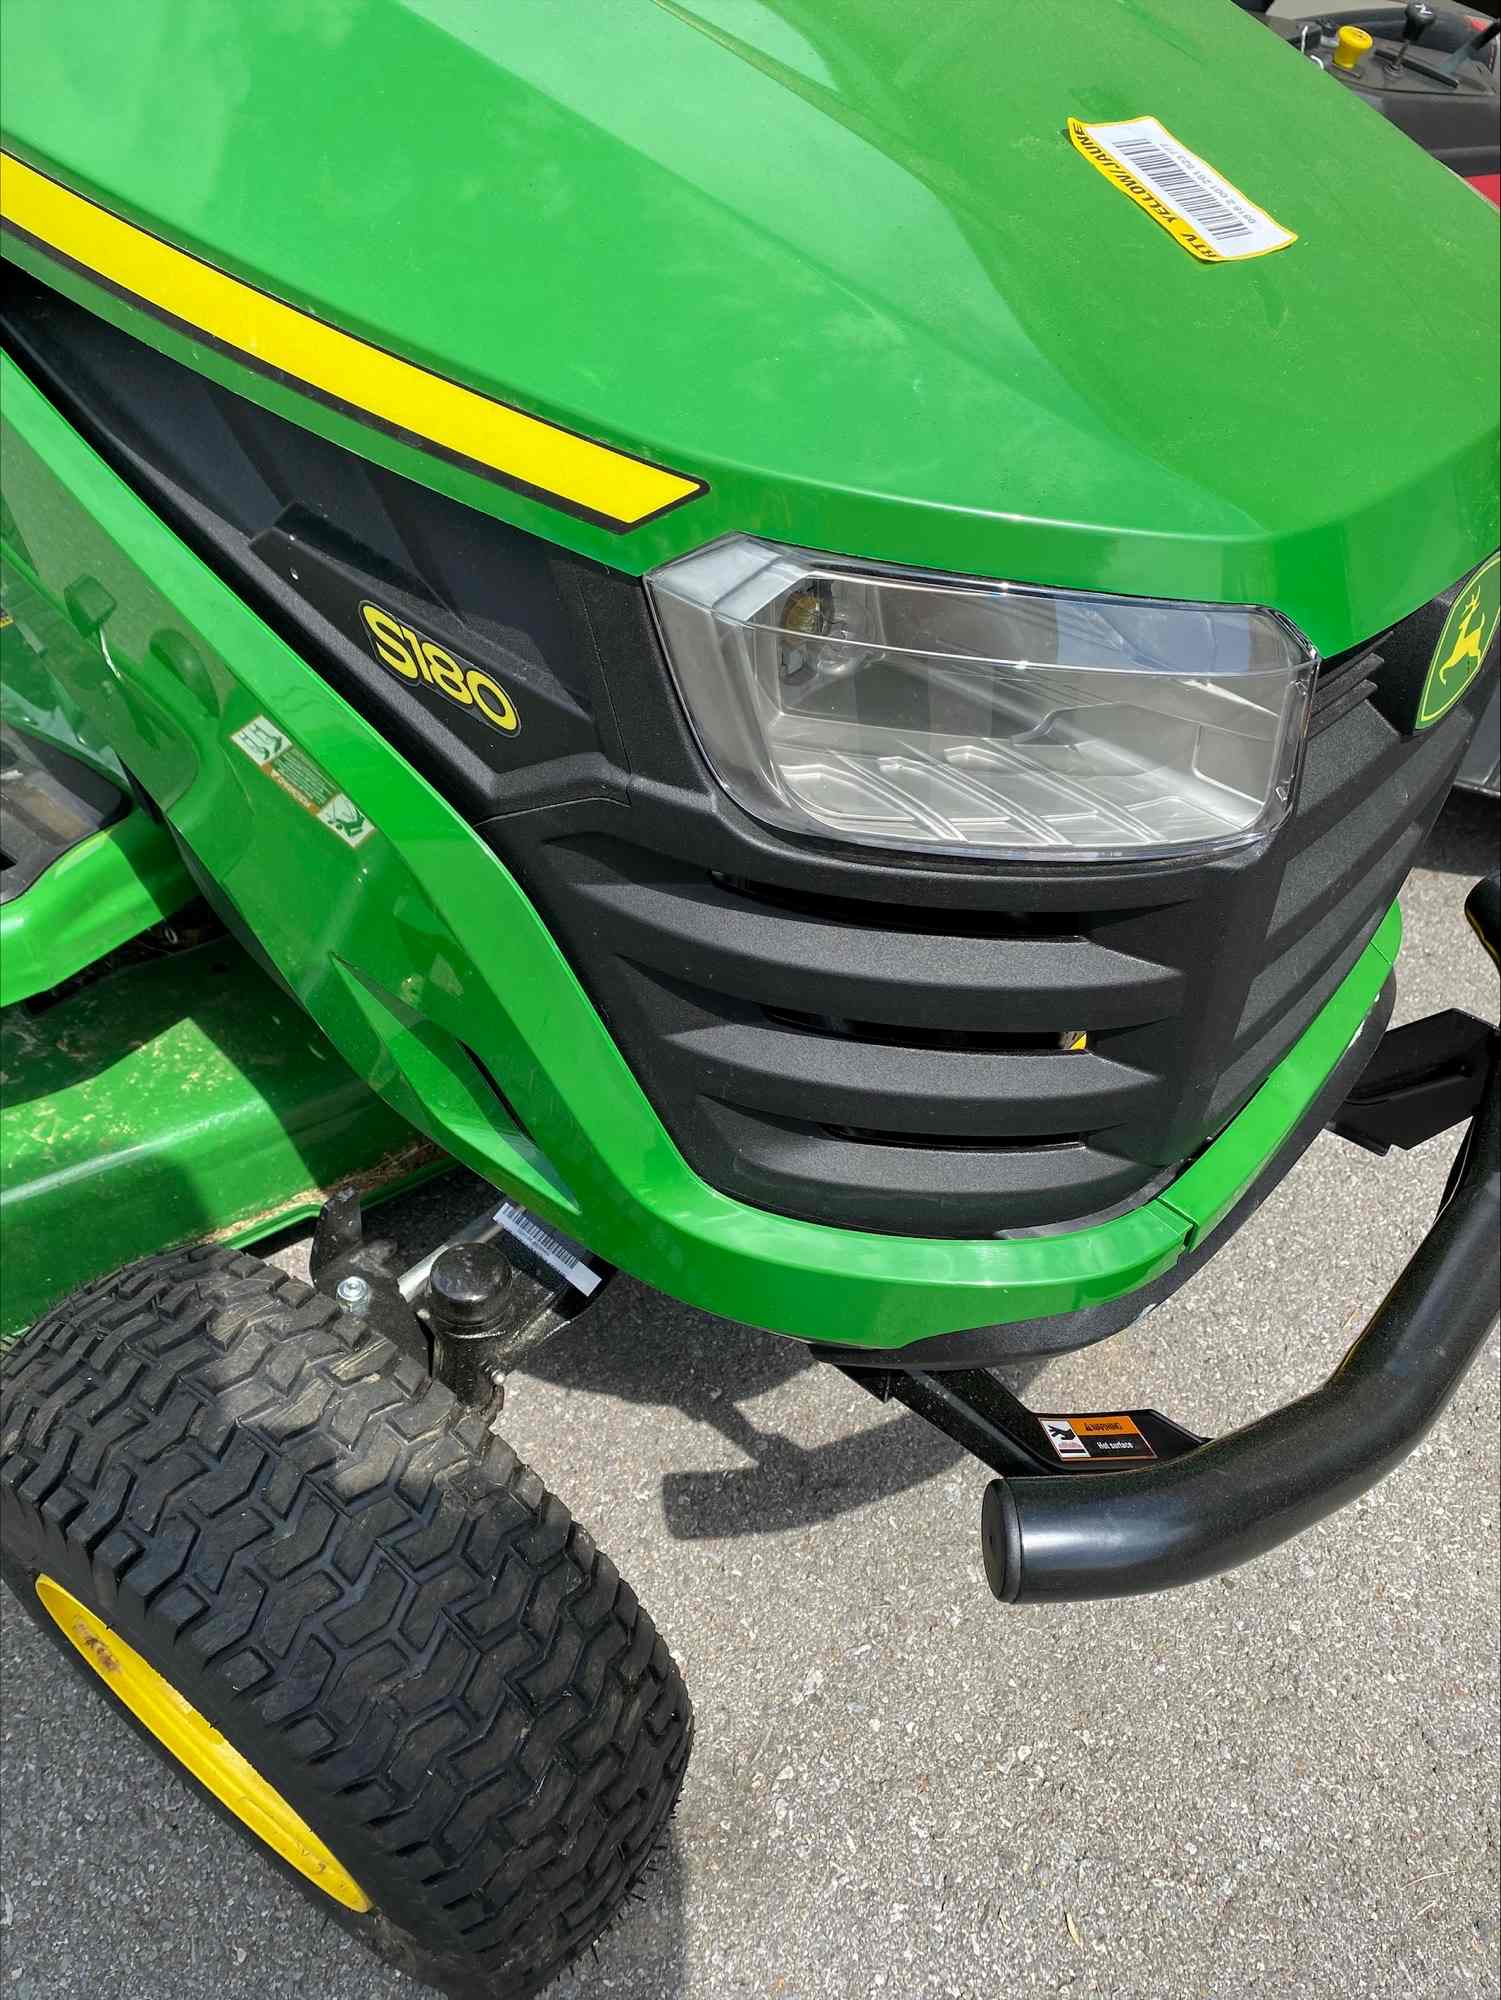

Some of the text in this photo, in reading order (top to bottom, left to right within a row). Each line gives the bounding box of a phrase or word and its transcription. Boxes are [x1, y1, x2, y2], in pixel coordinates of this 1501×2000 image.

[1072, 122, 1178, 224] YELLOW/JAUNE
[361, 604, 519, 732] S180
[1096, 1441, 1134, 1450] Hot surface
